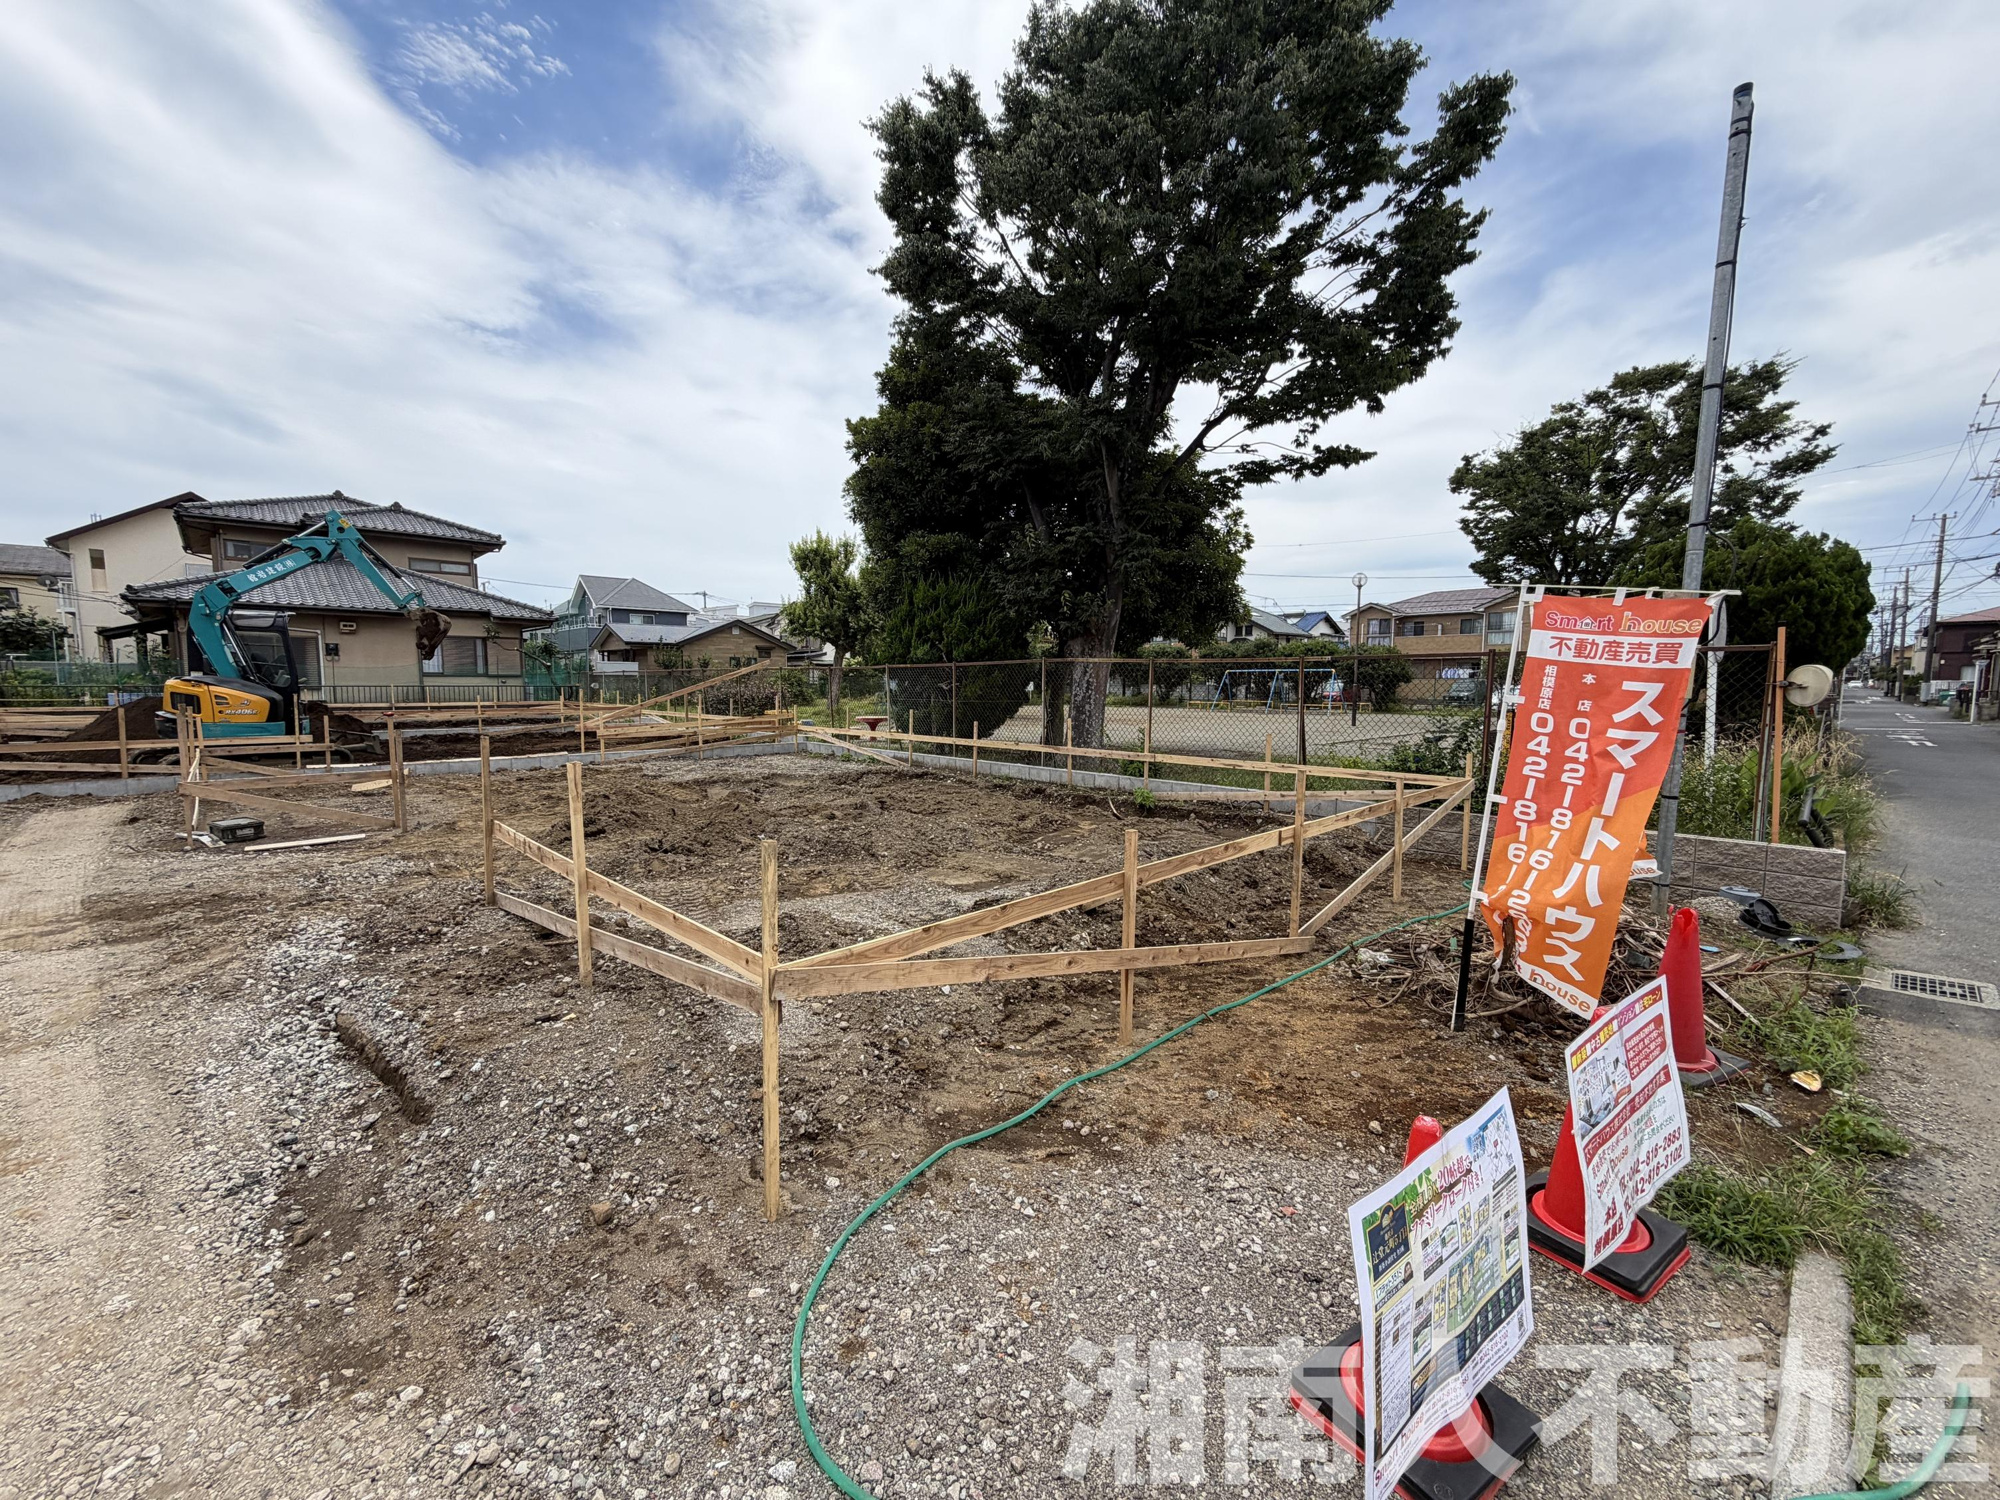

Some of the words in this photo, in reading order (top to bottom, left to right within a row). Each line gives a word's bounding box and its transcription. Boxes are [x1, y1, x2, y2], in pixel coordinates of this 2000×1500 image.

[1545, 610, 1614, 632] Smart
[1618, 611, 1704, 634] house
[1549, 636, 1683, 664] 不動産売買
[1537, 665, 1558, 711] 相模原店
[1577, 673, 1598, 712] 本店
[1542, 680, 1664, 981] スマートハウス
[1528, 968, 1591, 1012] house
